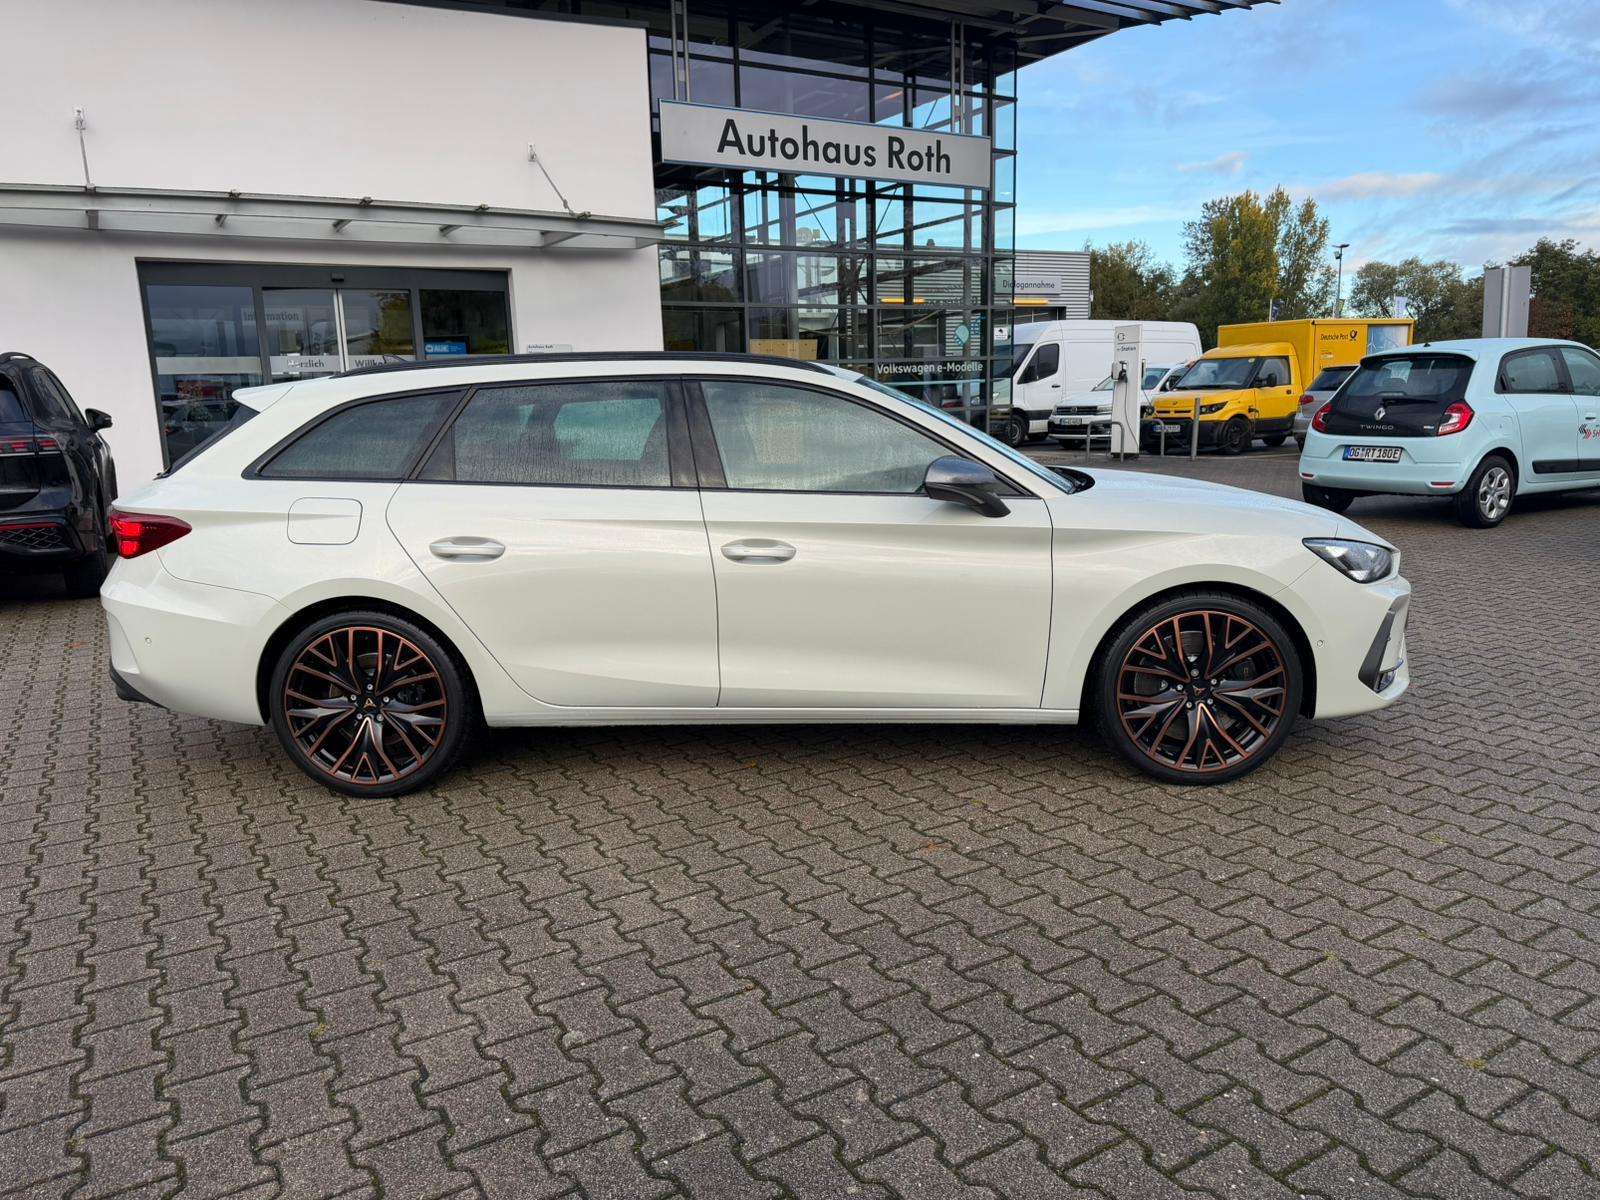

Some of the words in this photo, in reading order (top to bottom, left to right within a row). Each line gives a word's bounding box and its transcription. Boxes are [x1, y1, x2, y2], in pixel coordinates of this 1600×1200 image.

[716, 118, 876, 168] Autohaus
[888, 136, 950, 173] Roth
[1002, 279, 1055, 290] Diaogannahme
[1320, 333, 1339, 341] Deutsche
[877, 363, 935, 375] Volkswagen
[937, 361, 984, 373] e-Modelle
[1364, 448, 1377, 459] RT
[1376, 448, 1399, 460] 180E
